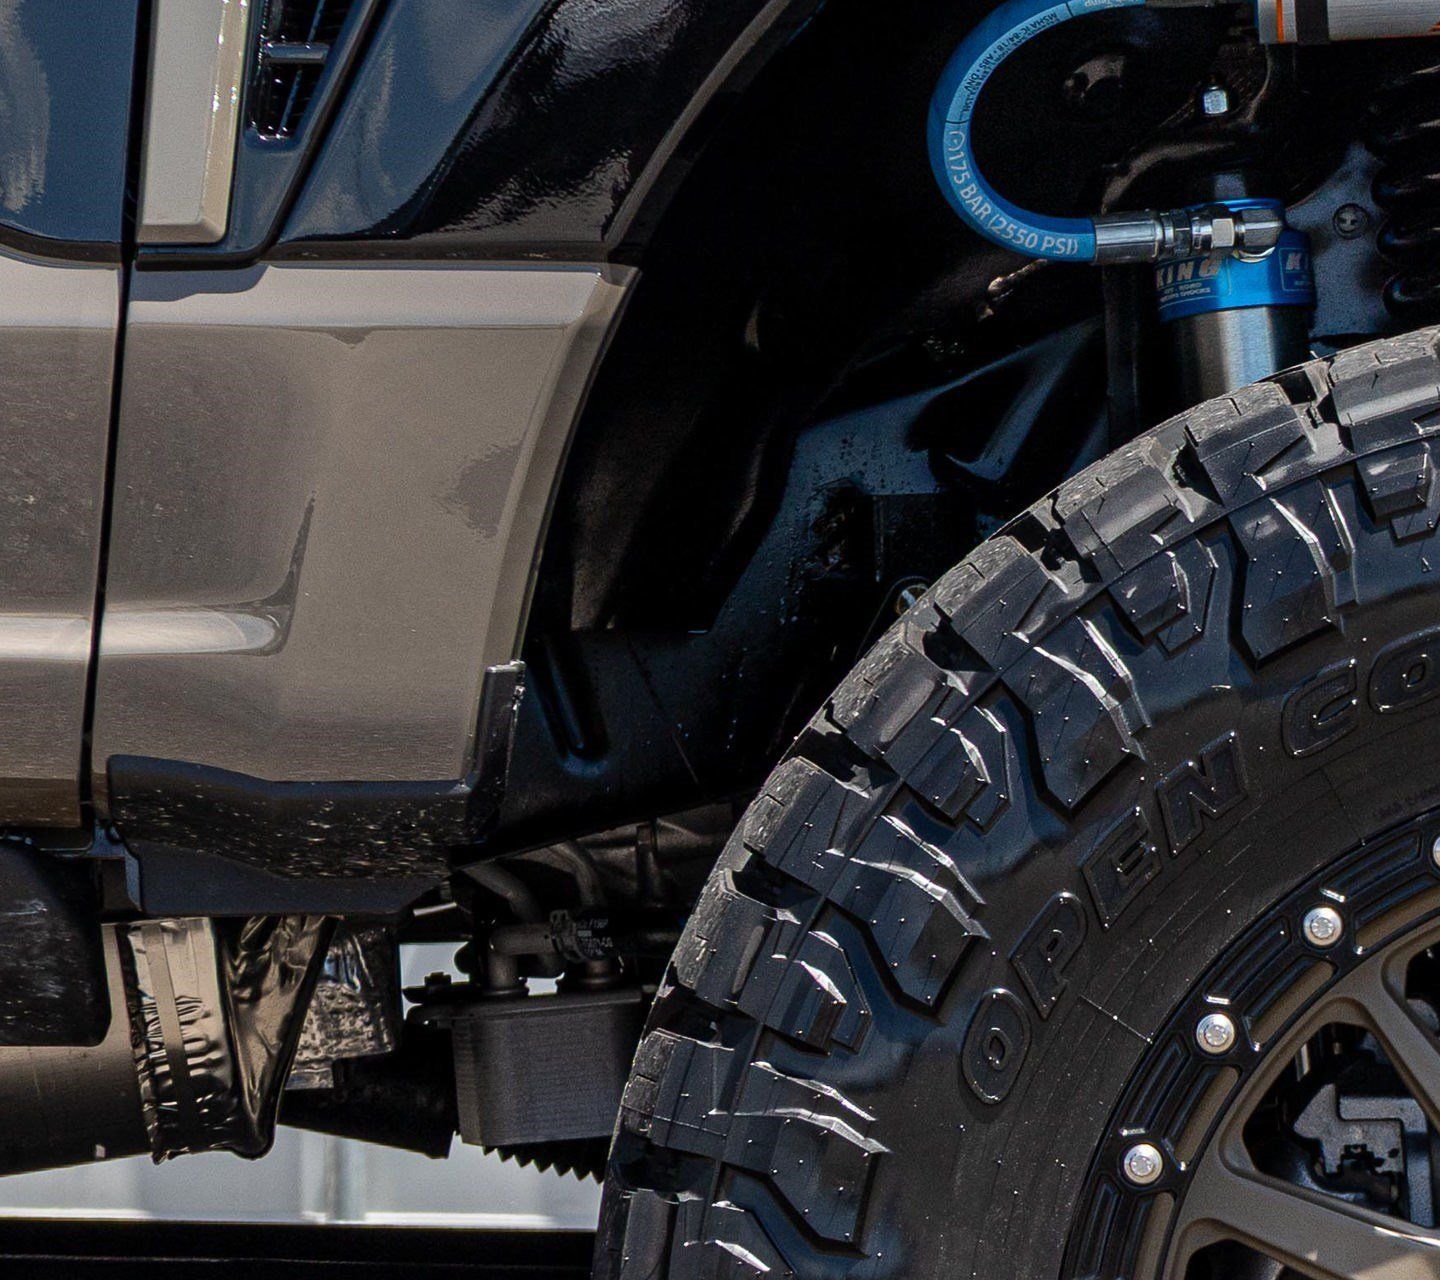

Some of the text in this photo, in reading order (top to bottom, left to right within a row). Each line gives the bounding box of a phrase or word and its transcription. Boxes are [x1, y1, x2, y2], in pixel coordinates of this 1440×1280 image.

[960, 182, 992, 220] BAR
[987, 213, 1039, 250] (2550
[1040, 235, 1079, 256] PSI)
[960, 730, 1252, 1106] OPEN
